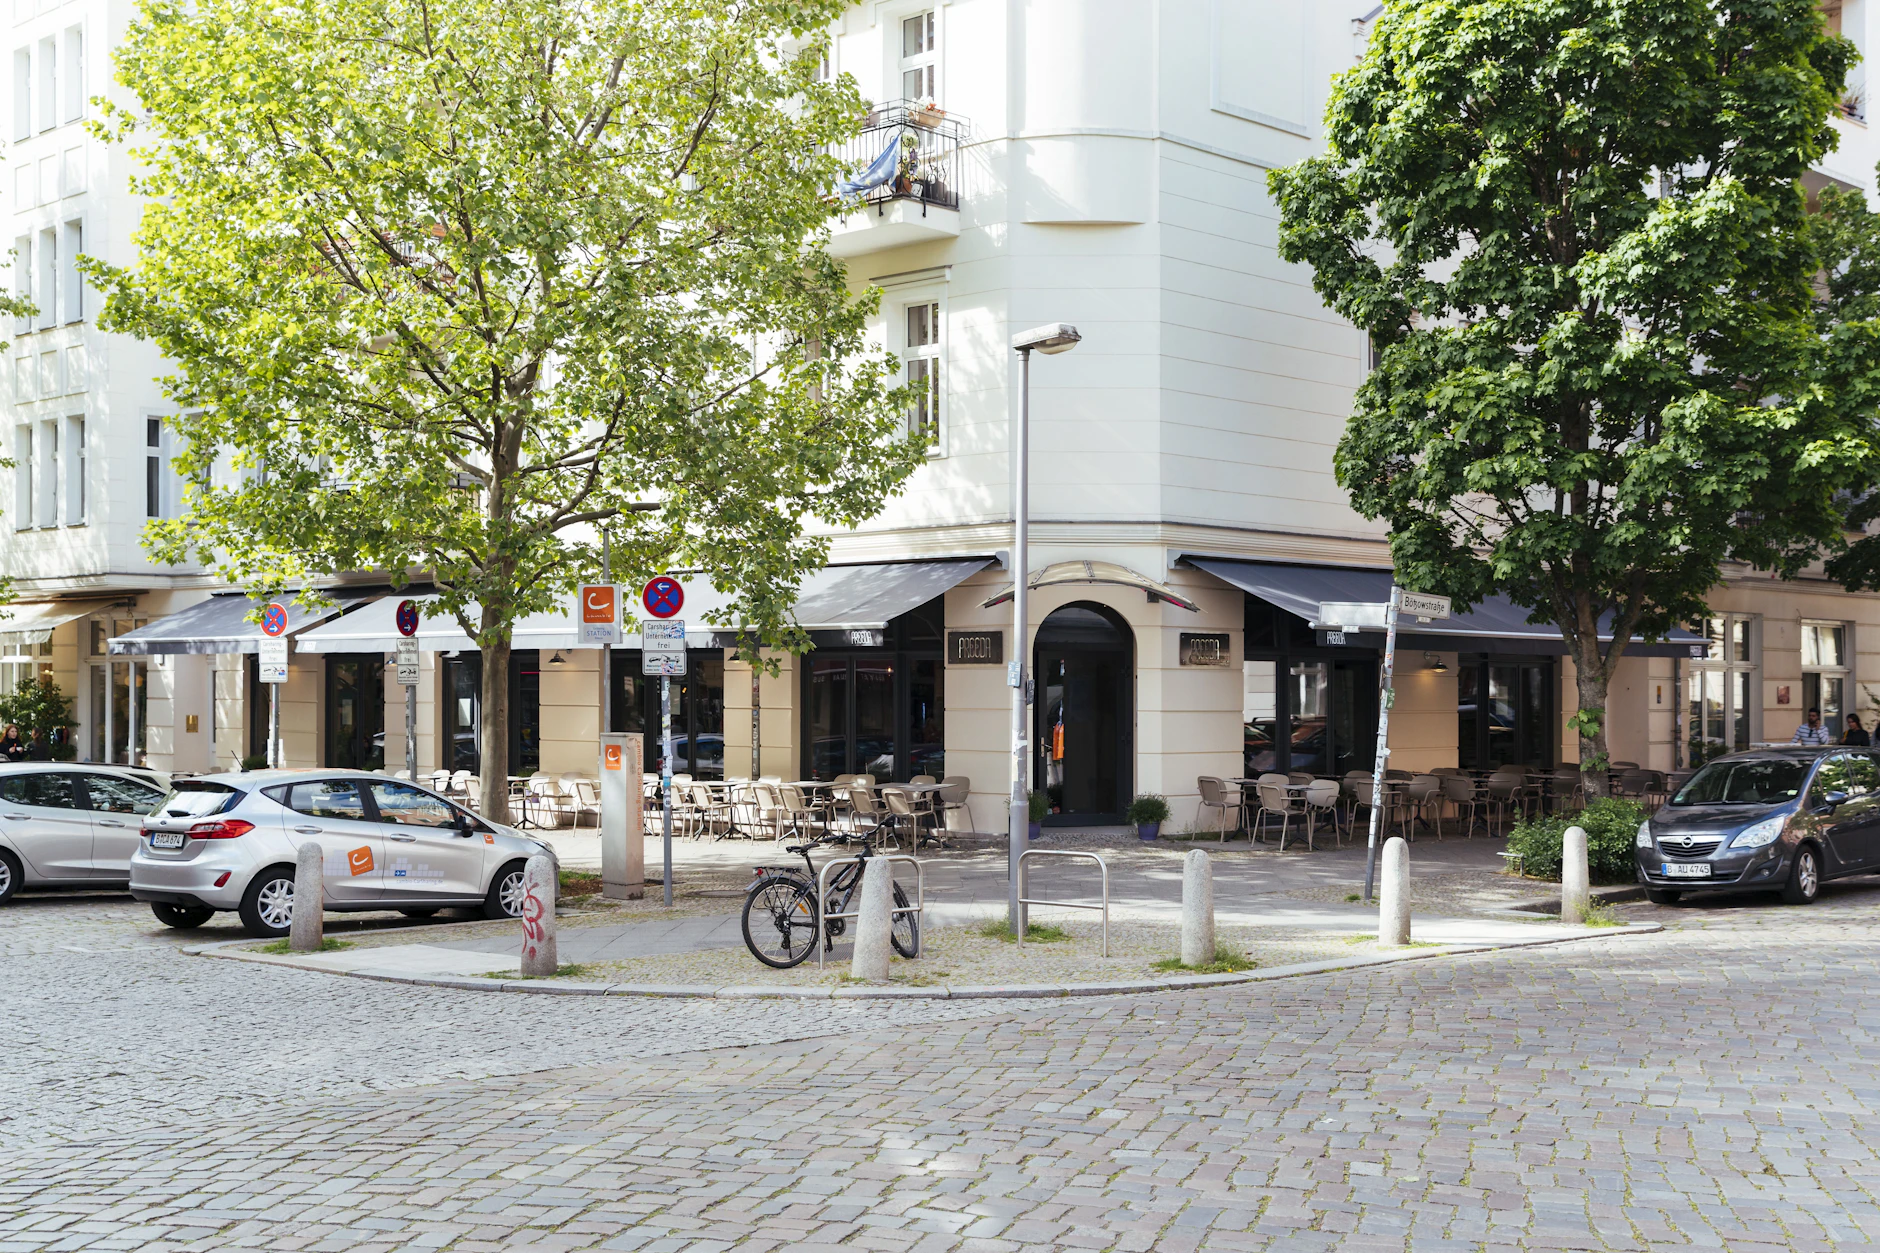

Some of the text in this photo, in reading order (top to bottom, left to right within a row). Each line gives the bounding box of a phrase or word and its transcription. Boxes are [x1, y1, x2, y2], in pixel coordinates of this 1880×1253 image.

[1404, 596, 1445, 614] Bötzowstraße
[958, 637, 991, 658] PREEDA
[1689, 865, 1710, 873] 4745
